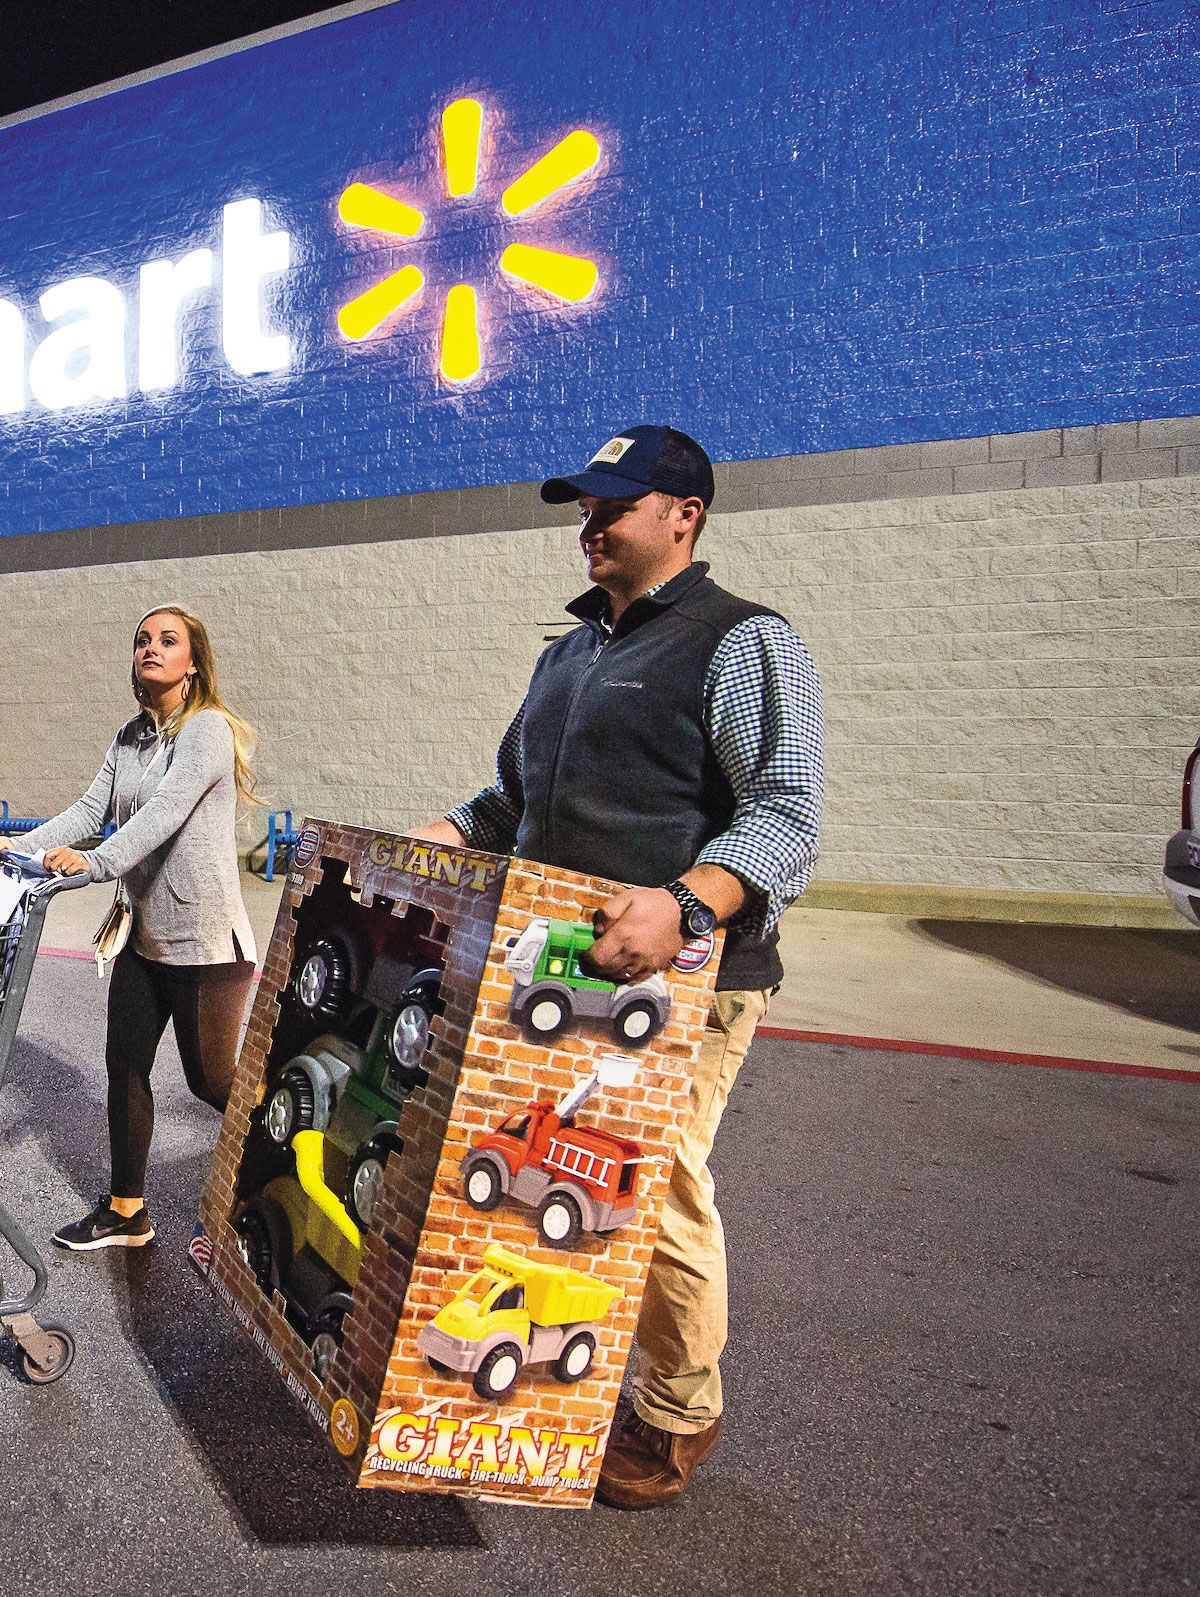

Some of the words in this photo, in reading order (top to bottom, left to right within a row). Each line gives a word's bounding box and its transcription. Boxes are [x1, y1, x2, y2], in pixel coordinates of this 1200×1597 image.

[369, 836, 498, 892] GIANT
[231, 1300, 251, 1332] TRUCK
[264, 1344, 285, 1373] TRUCK
[286, 1371, 307, 1402] DUMP
[306, 1395, 330, 1433] TRUCK
[335, 1408, 355, 1440] 2+
[377, 1411, 600, 1480] GIANT
[369, 1456, 426, 1475] RECYCLING
[427, 1464, 463, 1480] TRUCK
[531, 1475, 560, 1488] DUMP
[560, 1477, 591, 1490] TRUCK
